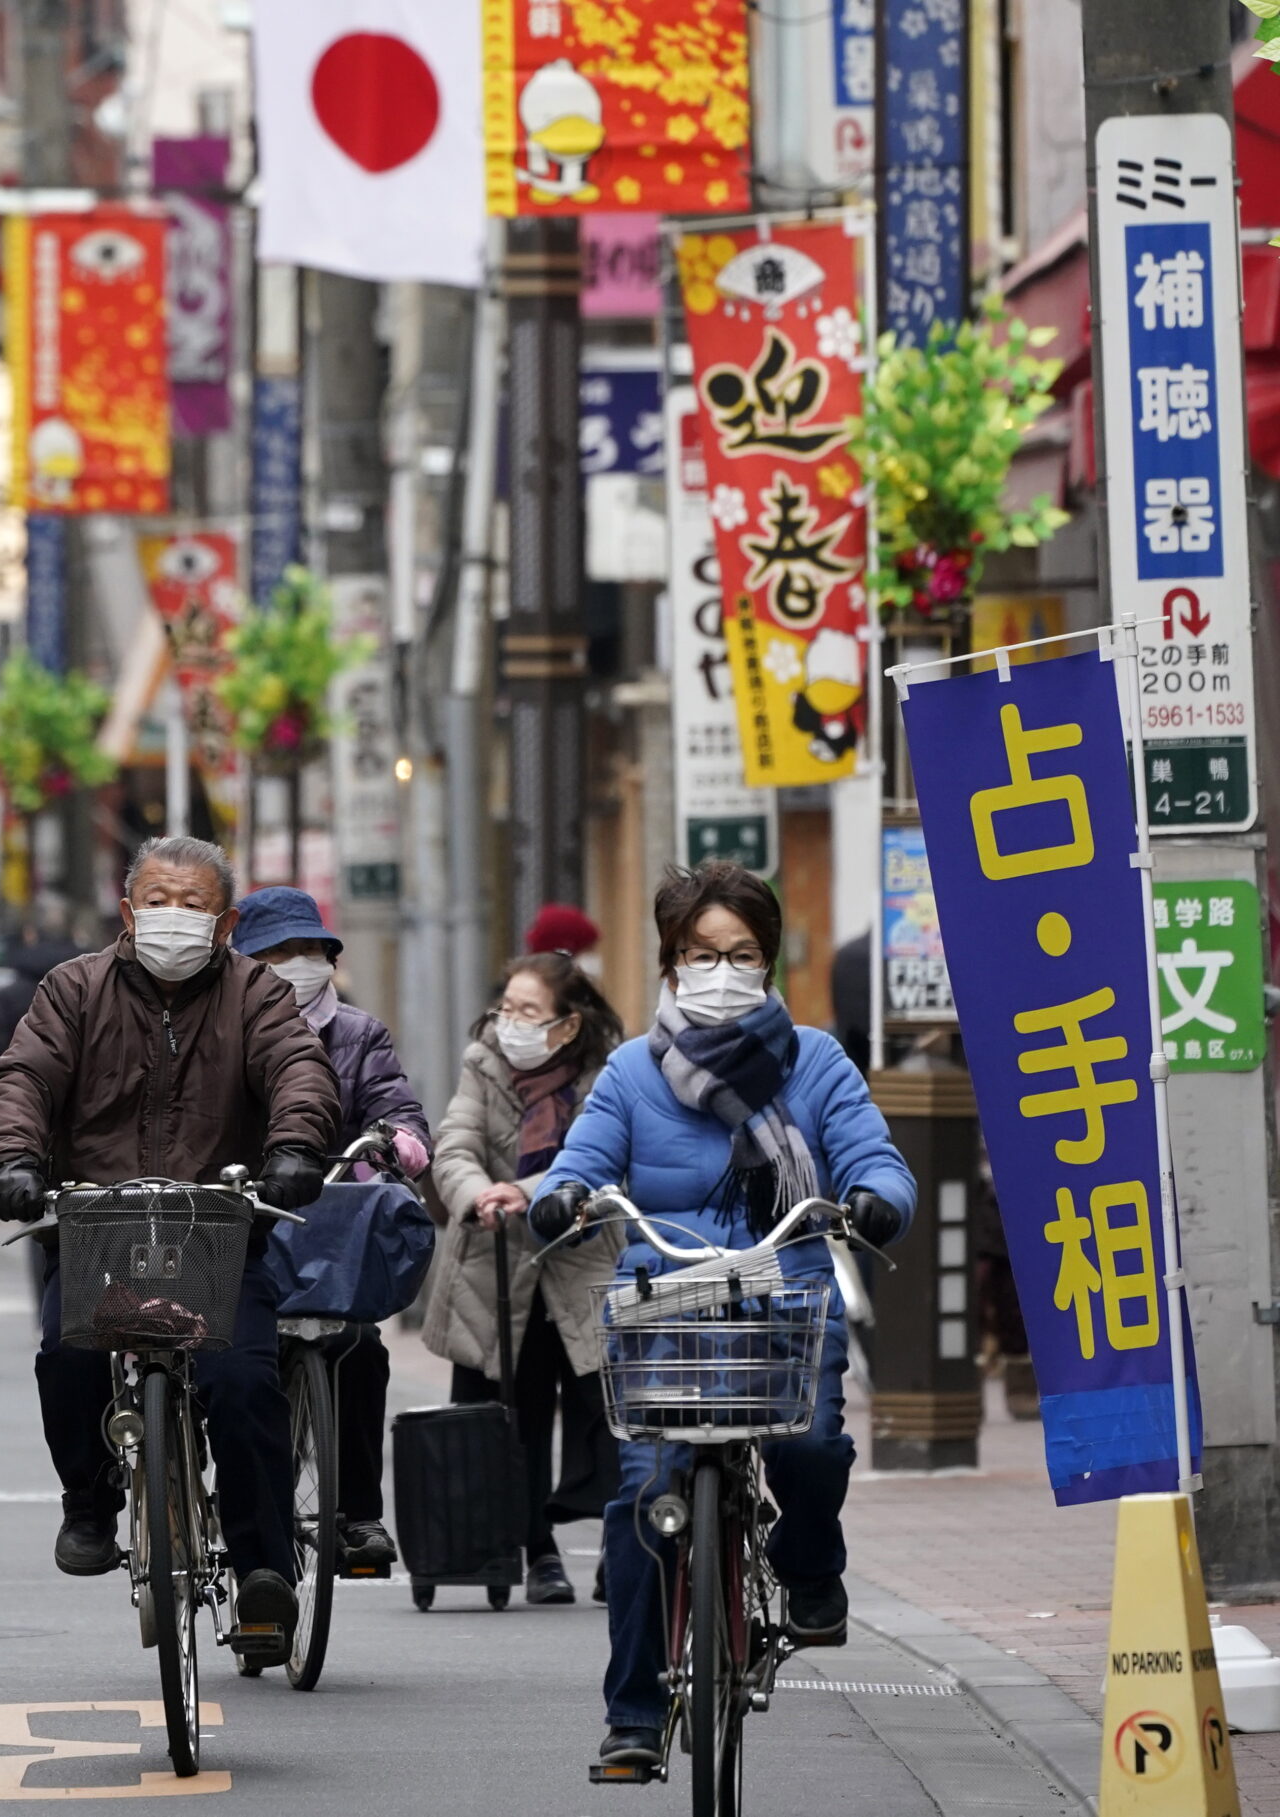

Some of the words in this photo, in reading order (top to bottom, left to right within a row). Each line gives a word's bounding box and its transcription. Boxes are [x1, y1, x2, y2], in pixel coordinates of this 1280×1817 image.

[1116, 158, 1217, 209] ミミー
[1133, 250, 1215, 554] 補聴器
[1141, 644, 1230, 667] この手前
[1142, 671, 1231, 694] 200m
[1155, 791, 1226, 816] 4-21
[1112, 1653, 1130, 1675] NO
[1132, 1651, 1183, 1675] PARKING
